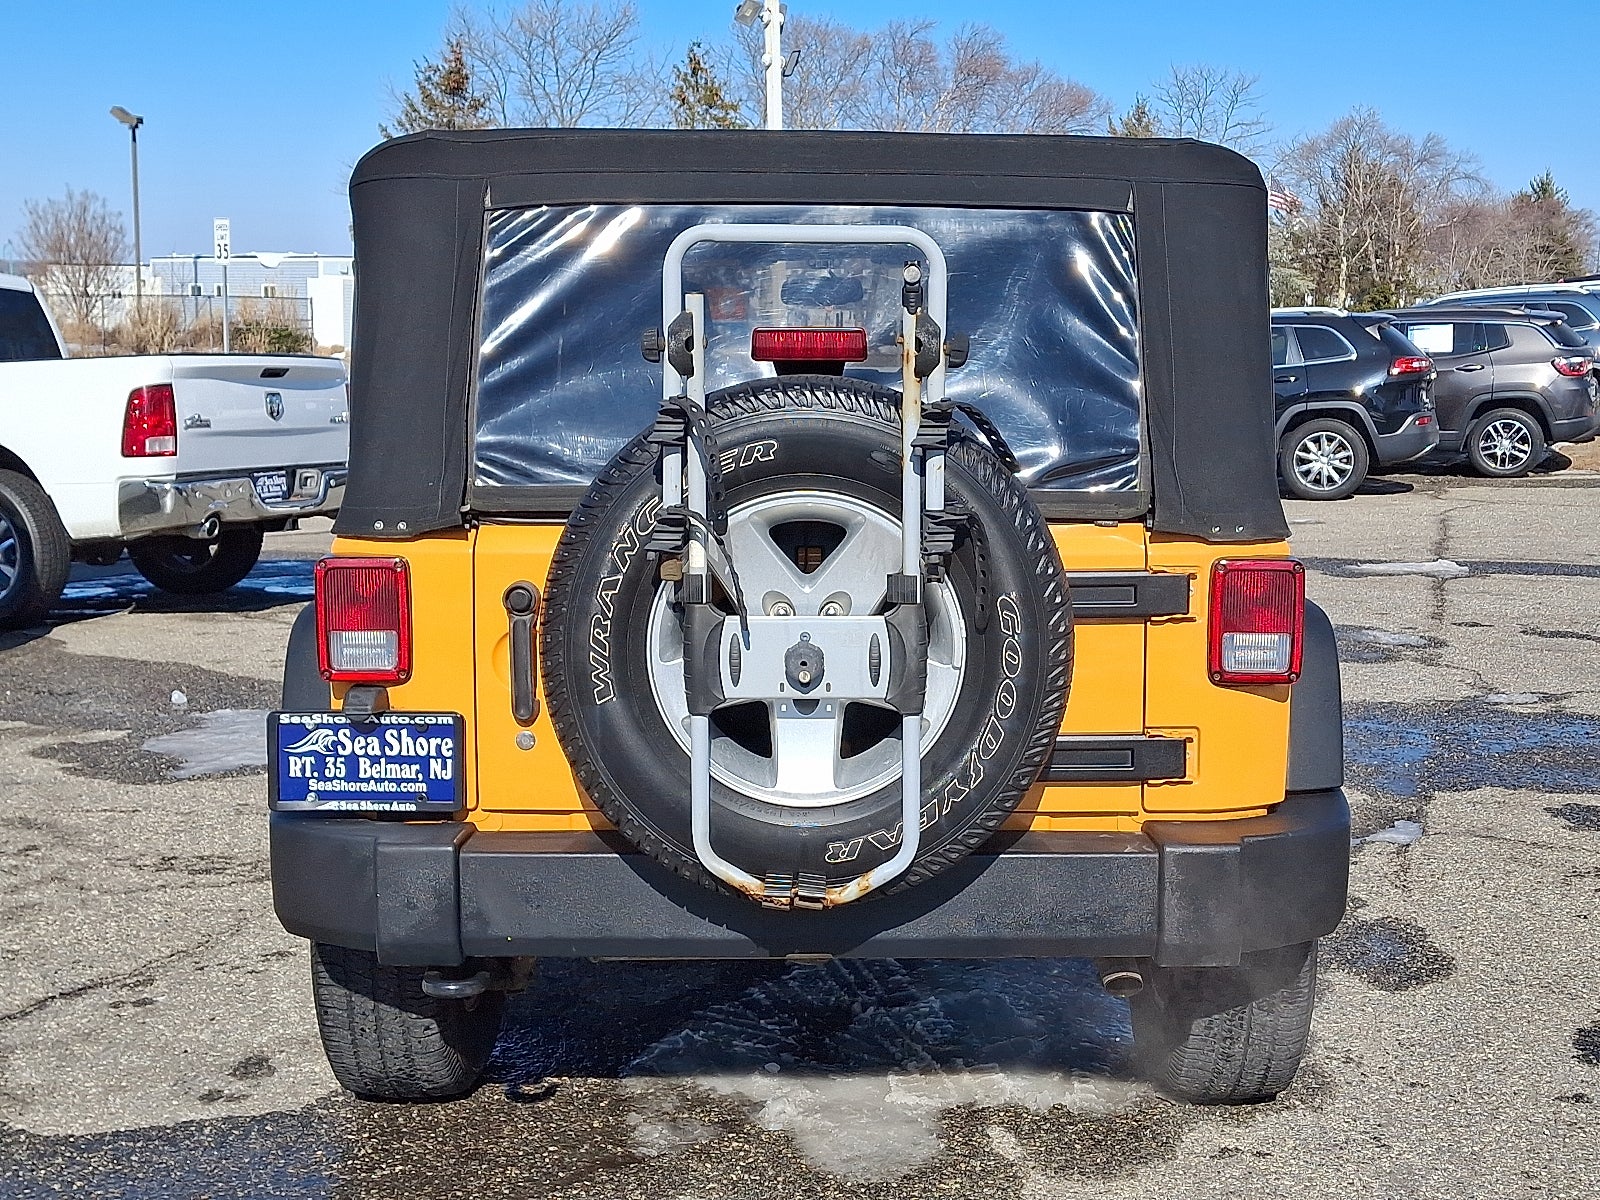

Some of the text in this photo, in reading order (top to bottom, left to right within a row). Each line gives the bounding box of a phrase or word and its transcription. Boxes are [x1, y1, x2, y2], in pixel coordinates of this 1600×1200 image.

[217, 243, 229, 259] 35
[337, 728, 454, 758] Sea Shore
[288, 756, 453, 782] RT. 35 Belmar, NJ
[308, 779, 428, 793] SeaShoreAuto.com
